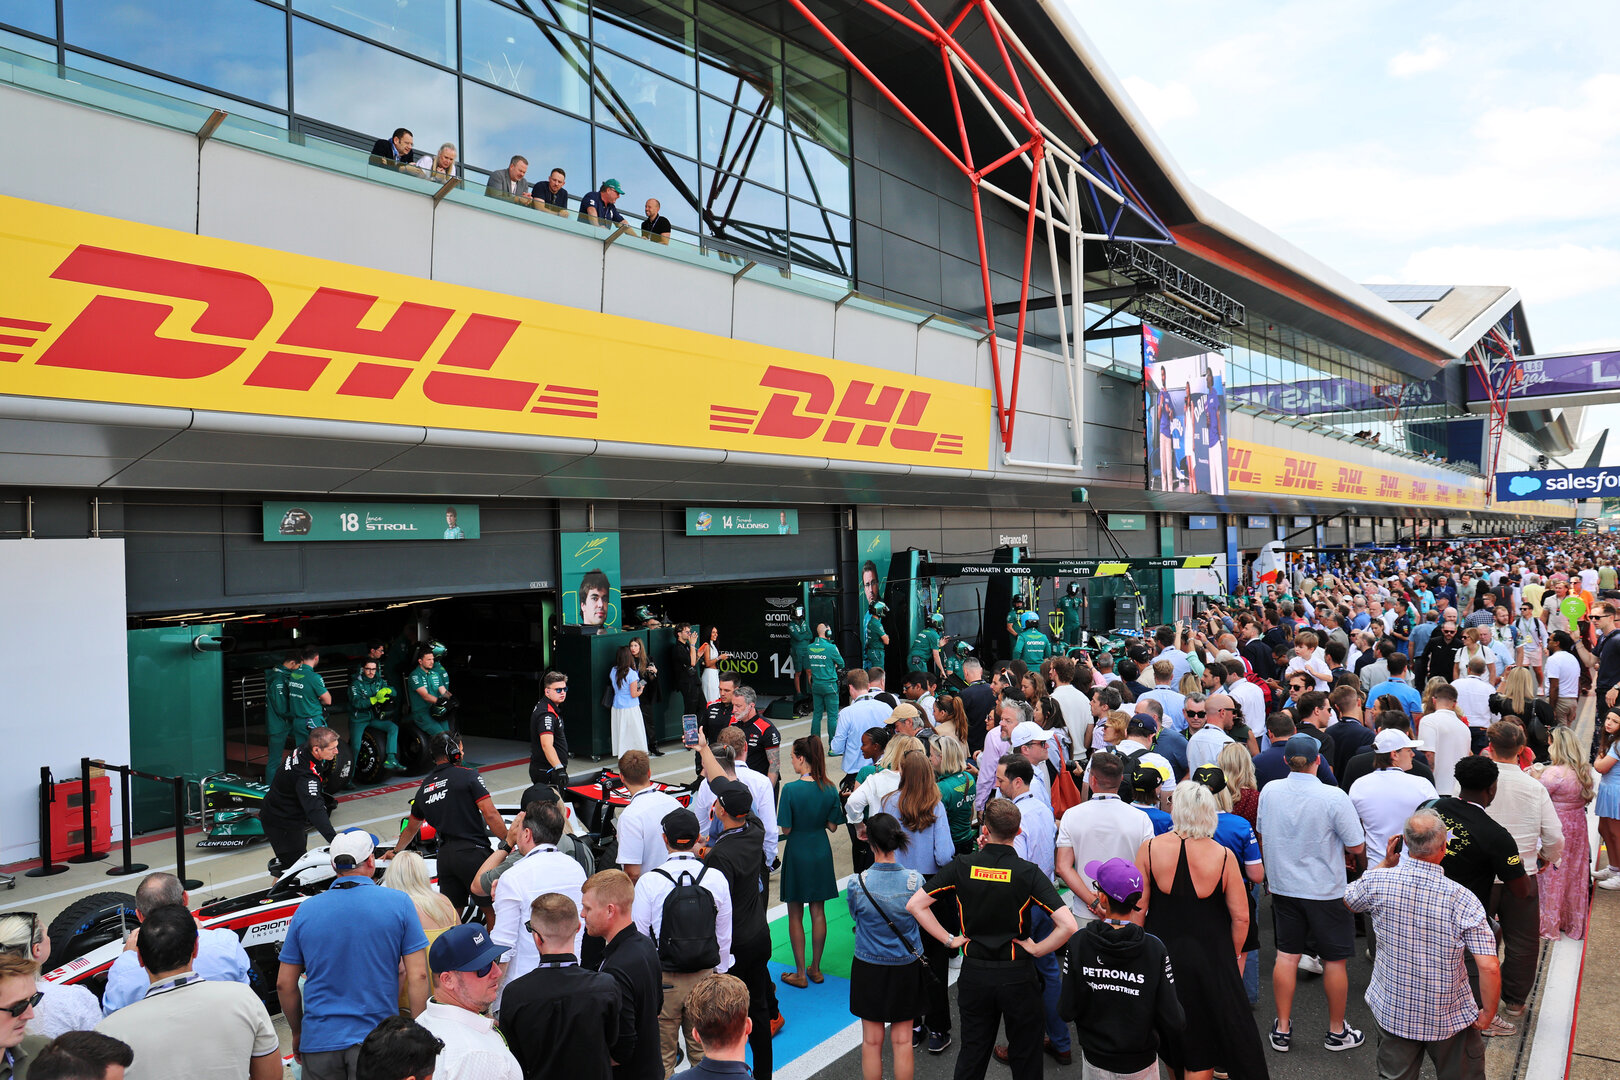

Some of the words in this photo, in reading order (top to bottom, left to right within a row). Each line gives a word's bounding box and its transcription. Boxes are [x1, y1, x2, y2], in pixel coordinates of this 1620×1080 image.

[35, 244, 540, 412] DHL
[753, 365, 938, 452] DHL
[1283, 457, 1318, 489] DHL
[1337, 467, 1363, 495] DHL
[1546, 471, 1620, 493] salesfo
[340, 513, 359, 532] 18
[366, 523, 418, 531] STROLL
[722, 515, 733, 529] 14
[1000, 535, 1021, 545] Entrance
[1021, 534, 1028, 544] 02
[1073, 566, 1090, 574] arm
[769, 652, 796, 679] 14
[425, 788, 449, 805] HAAS
[974, 868, 1008, 880] PIRELLI
[1082, 966, 1145, 984] PETRONAS
